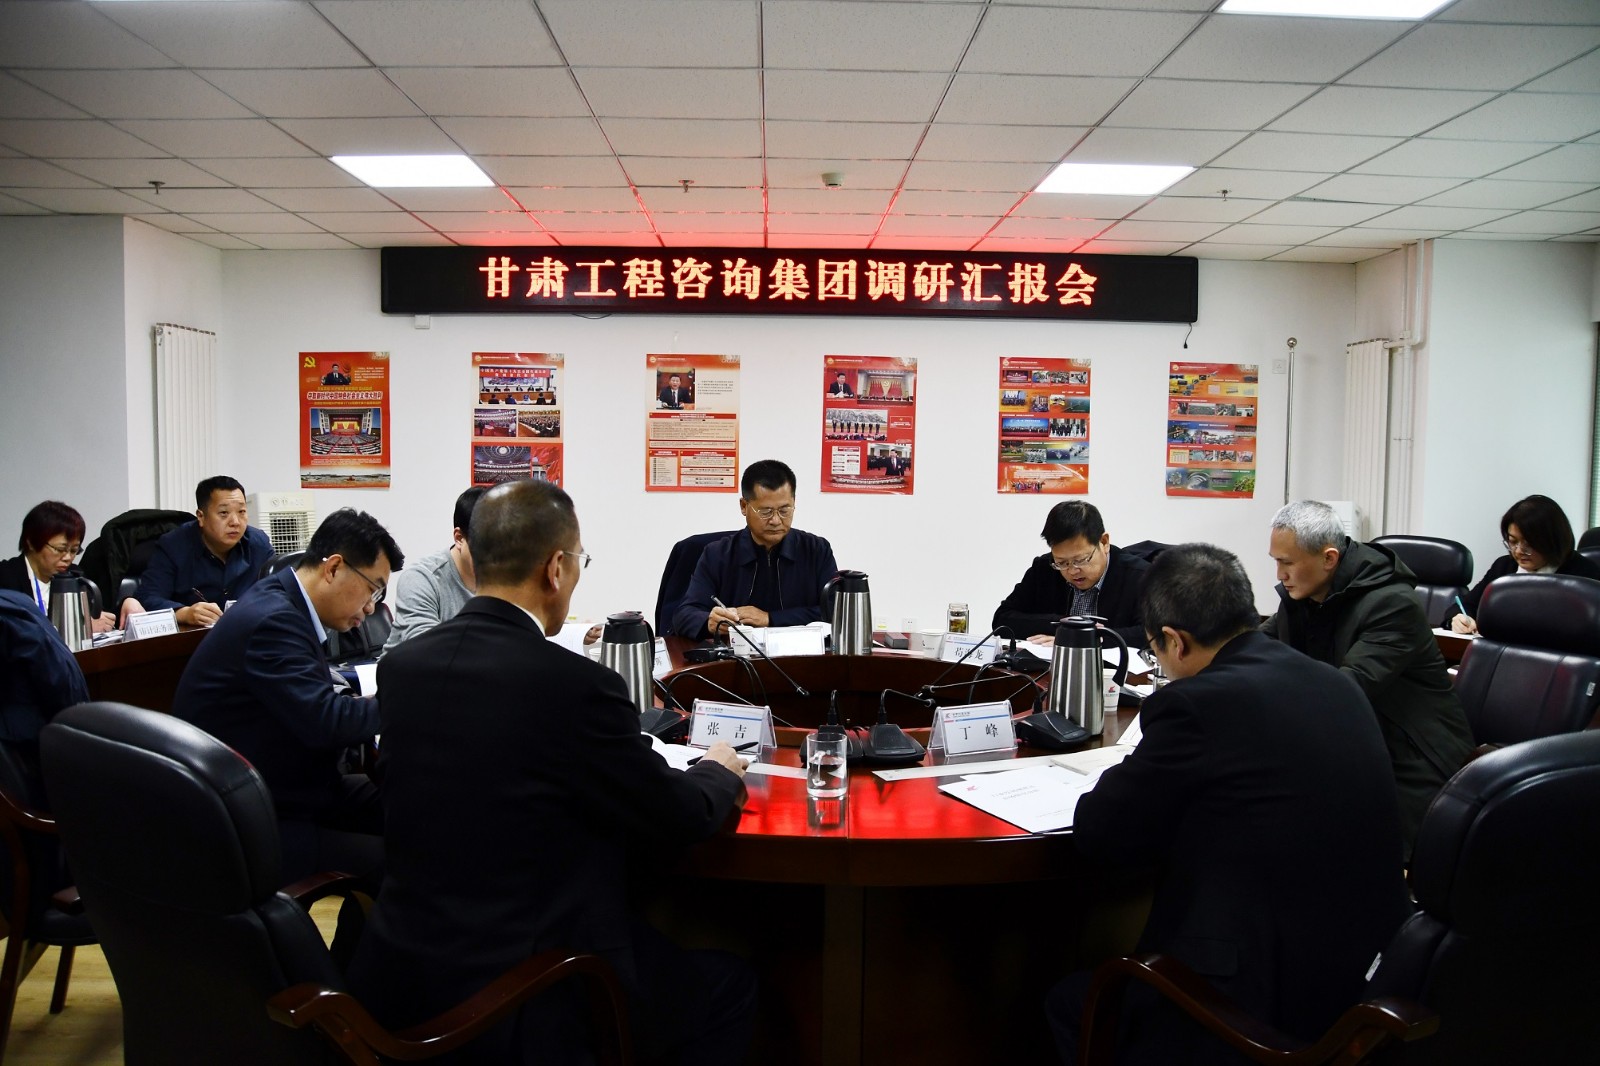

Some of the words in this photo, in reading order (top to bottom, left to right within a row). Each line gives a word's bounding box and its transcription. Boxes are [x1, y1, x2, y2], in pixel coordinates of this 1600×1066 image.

[478, 256, 1098, 306] 甘肃工程咨询集团调研汇报会
